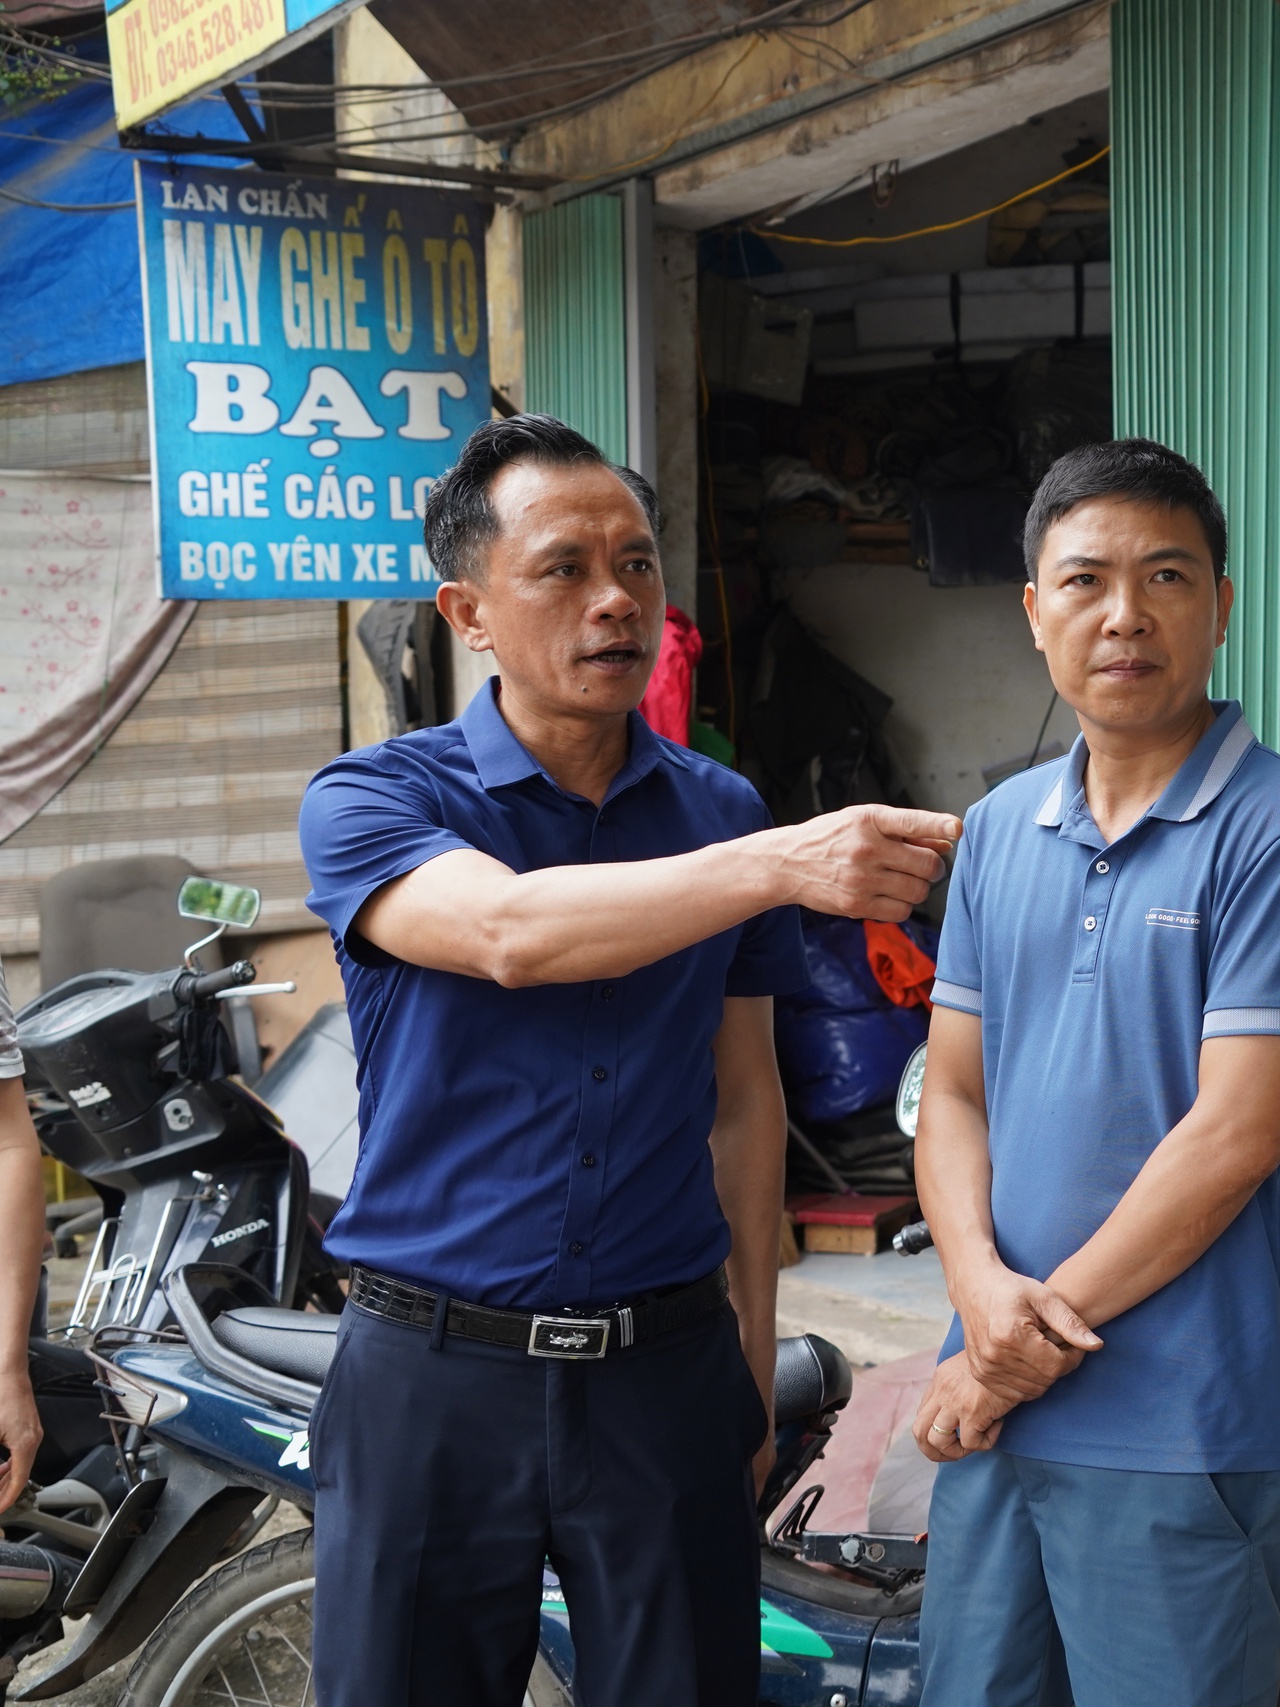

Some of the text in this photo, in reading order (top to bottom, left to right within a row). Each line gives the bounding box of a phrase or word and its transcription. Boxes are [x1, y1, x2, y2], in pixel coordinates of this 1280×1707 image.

[161, 180, 329, 219] LAN CHẤN
[163, 194, 479, 357] MAY GHẾ Ô TÔ
[186, 361, 468, 458] BẠT
[178, 458, 271, 518] GHẾ
[284, 465, 375, 520] CÁC
[180, 541, 257, 589] BỌC
[268, 535, 342, 582] YÊN
[352, 544, 399, 582] XE
[1176, 916, 1189, 924] FEEL
[211, 1218, 270, 1248] HONDA
